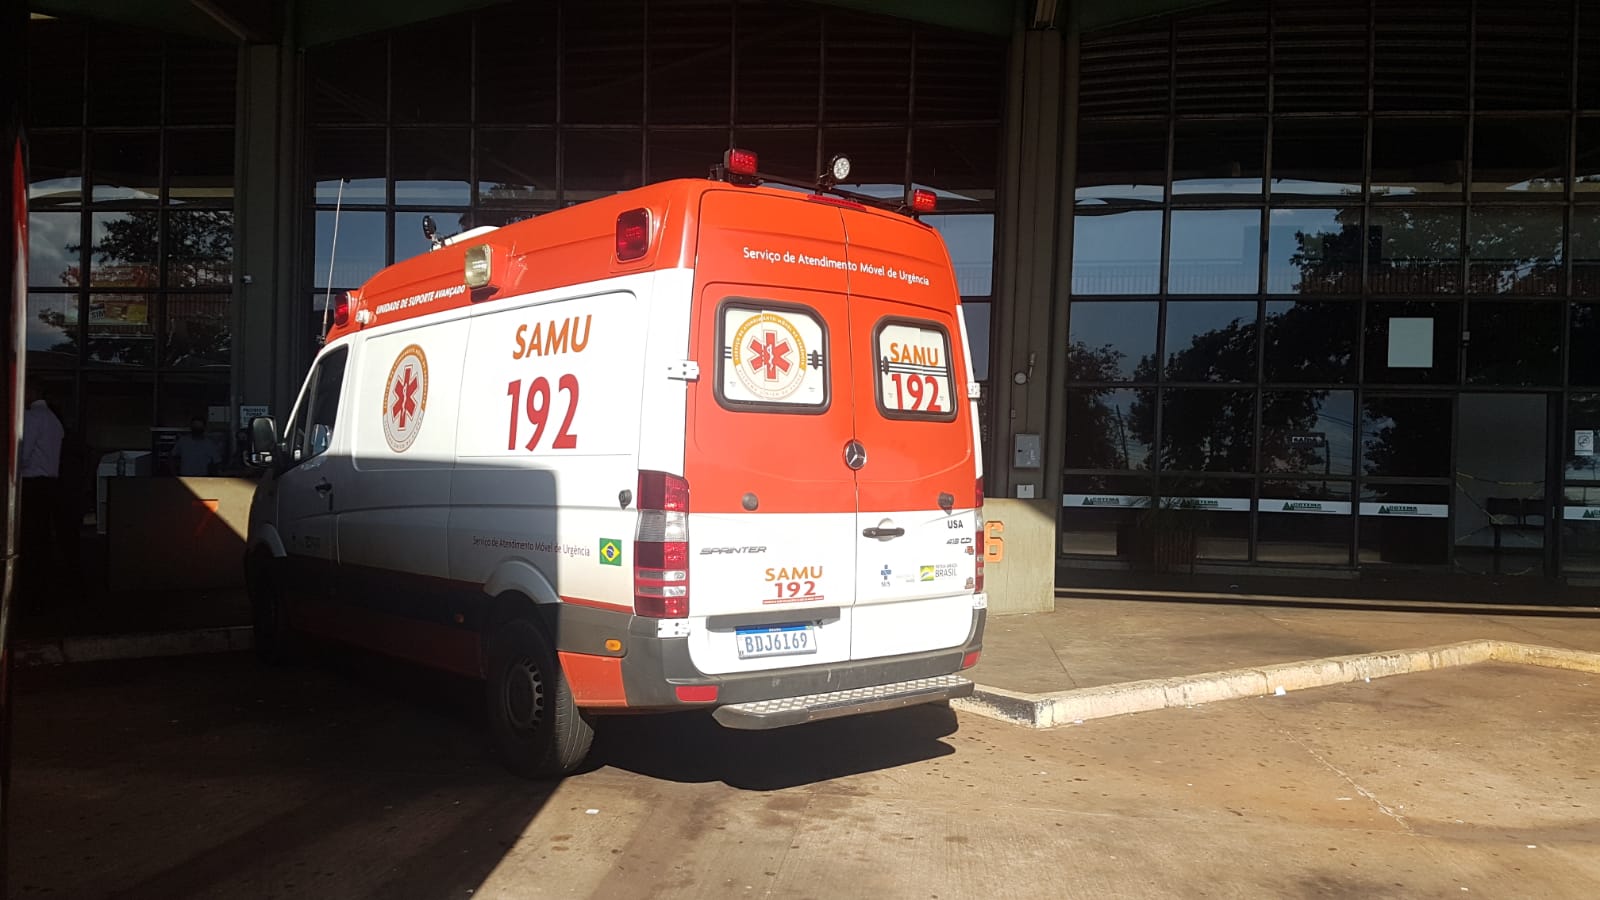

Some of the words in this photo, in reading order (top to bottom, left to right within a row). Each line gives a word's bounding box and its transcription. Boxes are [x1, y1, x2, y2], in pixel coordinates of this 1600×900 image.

[743, 247, 781, 263] Serviço
[783, 251, 796, 263] de
[798, 254, 857, 271] Atendimento
[860, 262, 885, 276] Móvel
[887, 266, 897, 279] de
[900, 269, 930, 286] Urgência
[375, 300, 400, 315] UNIDADE
[400, 298, 409, 309] DE
[408, 291, 435, 307] SUPORTE
[434, 284, 466, 299] AVANÇADO
[512, 314, 592, 360] SAMU
[890, 342, 939, 367] SAMU
[891, 373, 942, 412] 192
[507, 373, 579, 452] 192
[947, 520, 963, 529] USA
[473, 535, 491, 547] Serviço
[492, 537, 499, 547] de
[499, 538, 534, 551] Atendimento
[535, 541, 553, 553] Móvel
[554, 542, 562, 553] de
[563, 544, 590, 558] Urgência
[700, 546, 767, 555] SPRINTER
[984, 520, 1004, 562] 6
[765, 566, 823, 582] SAMU
[935, 568, 958, 577] BRASIL
[774, 580, 816, 598] 192
[744, 631, 808, 654] BDJ6169
